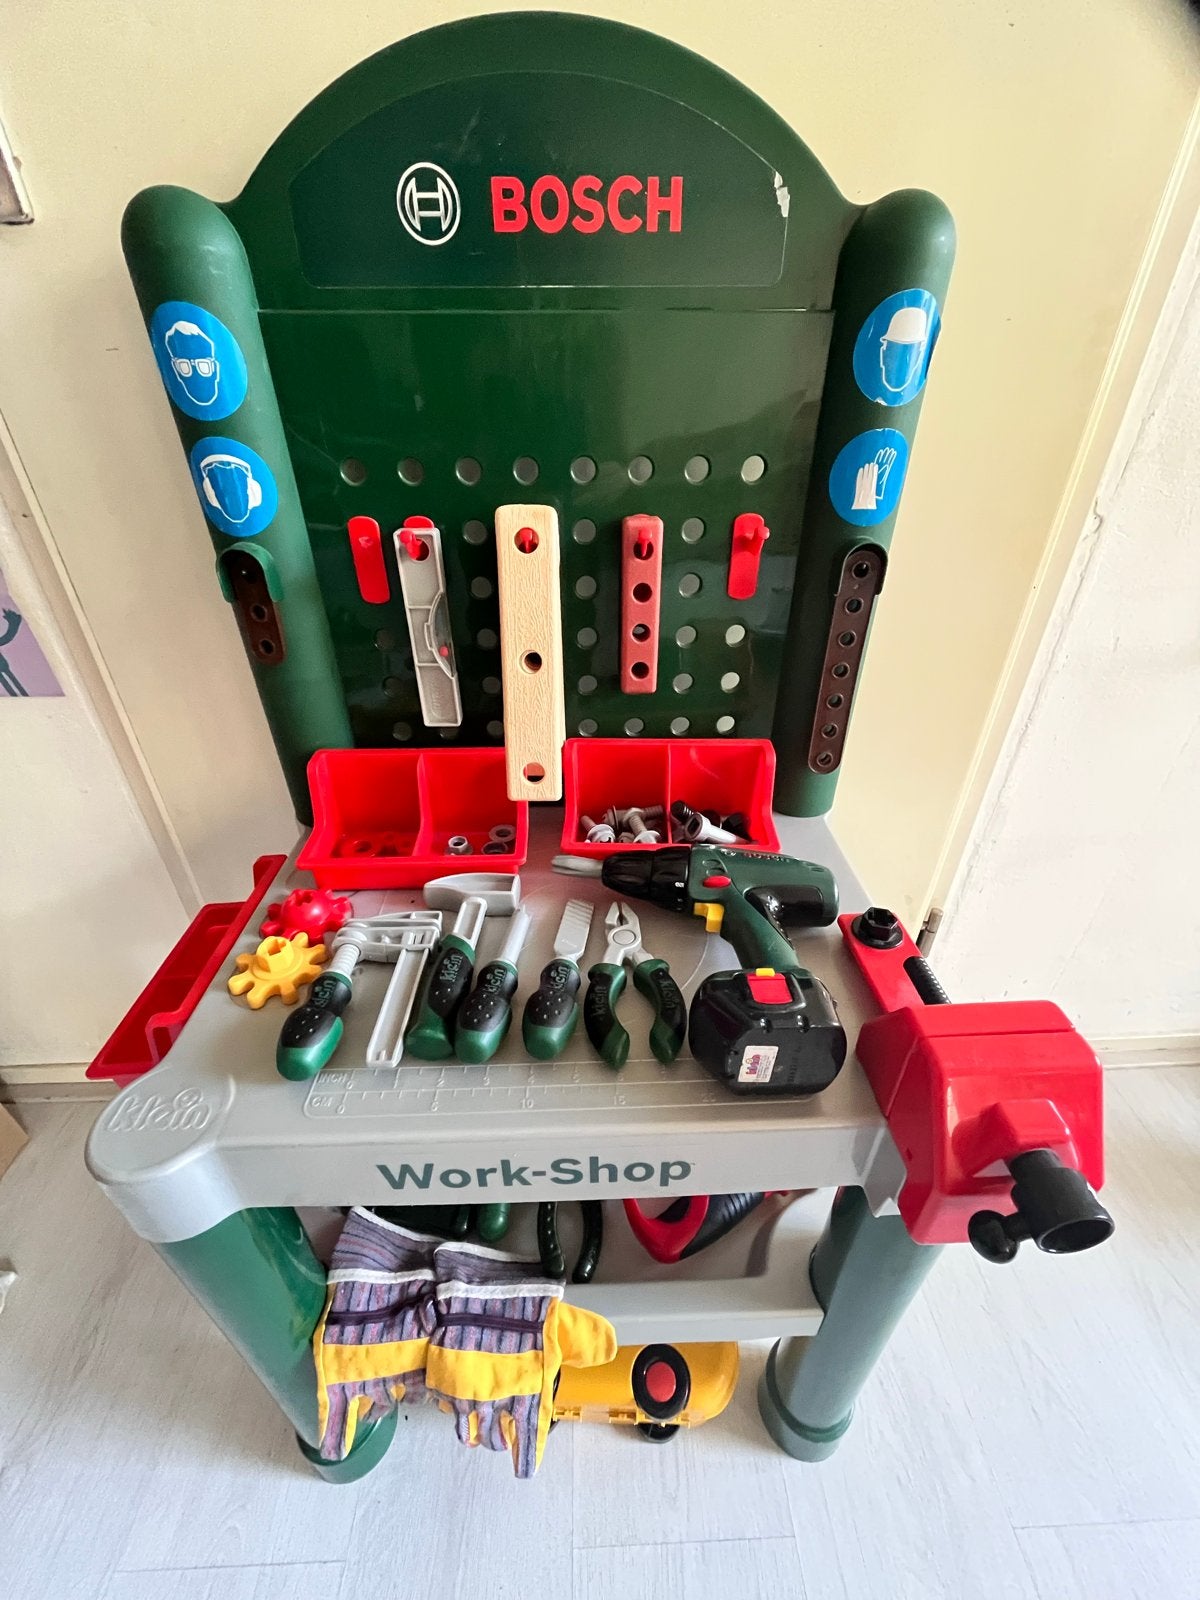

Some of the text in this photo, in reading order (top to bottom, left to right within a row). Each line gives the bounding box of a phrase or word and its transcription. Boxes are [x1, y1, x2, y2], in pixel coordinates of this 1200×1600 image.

[490, 174, 684, 234] BOSCH
[318, 1072, 348, 1084] INCH
[346, 1080, 354, 1090] 0
[436, 1078, 445, 1088] 2
[483, 1076, 491, 1086] 3
[527, 1073, 536, 1084] 4
[107, 1087, 213, 1132] klein
[311, 1097, 334, 1107] CM
[336, 1104, 346, 1114] 0
[520, 1098, 535, 1109] 10
[613, 1095, 627, 1106] 15
[376, 1156, 692, 1190] Work-Shop
